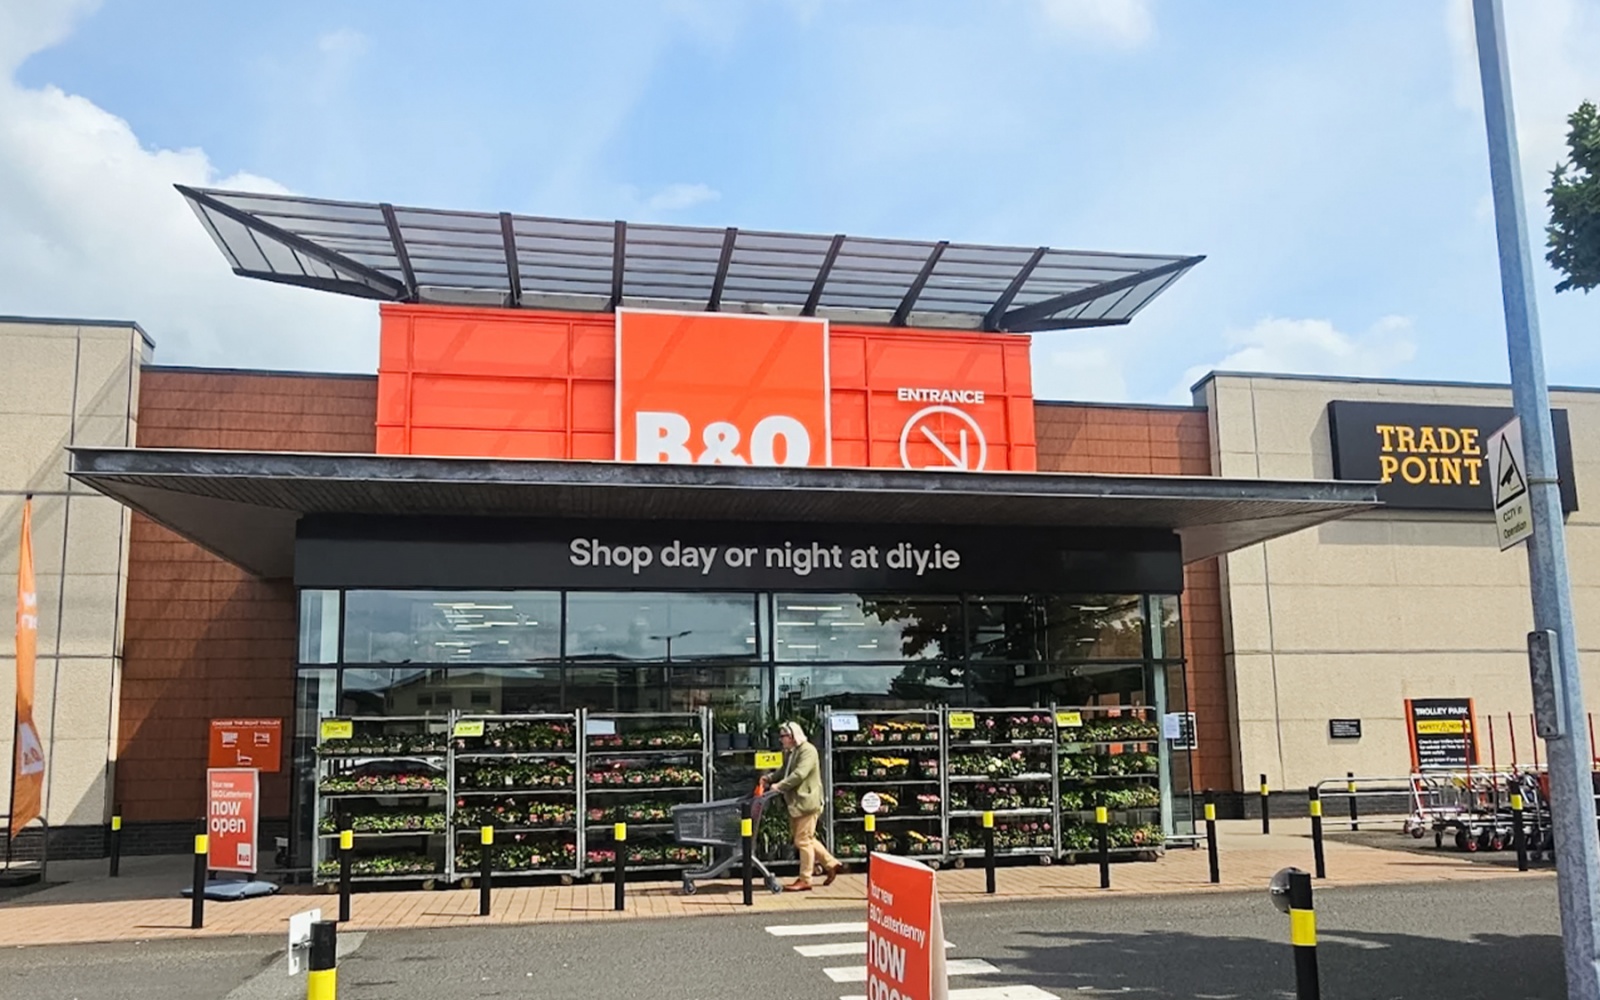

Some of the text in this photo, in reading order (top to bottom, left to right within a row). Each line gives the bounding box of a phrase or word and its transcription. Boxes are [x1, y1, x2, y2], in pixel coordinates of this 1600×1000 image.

[897, 387, 985, 404] ENTRANCE
[1376, 424, 1481, 455] TRADE
[1379, 455, 1483, 485] POINT
[569, 538, 961, 576] Shop day or night at diy.ie
[1414, 706, 1469, 716] TROLLEY PARK
[211, 800, 241, 816] now
[211, 817, 247, 838] open
[881, 911, 926, 949] Letterkenny
[869, 930, 906, 984] now
